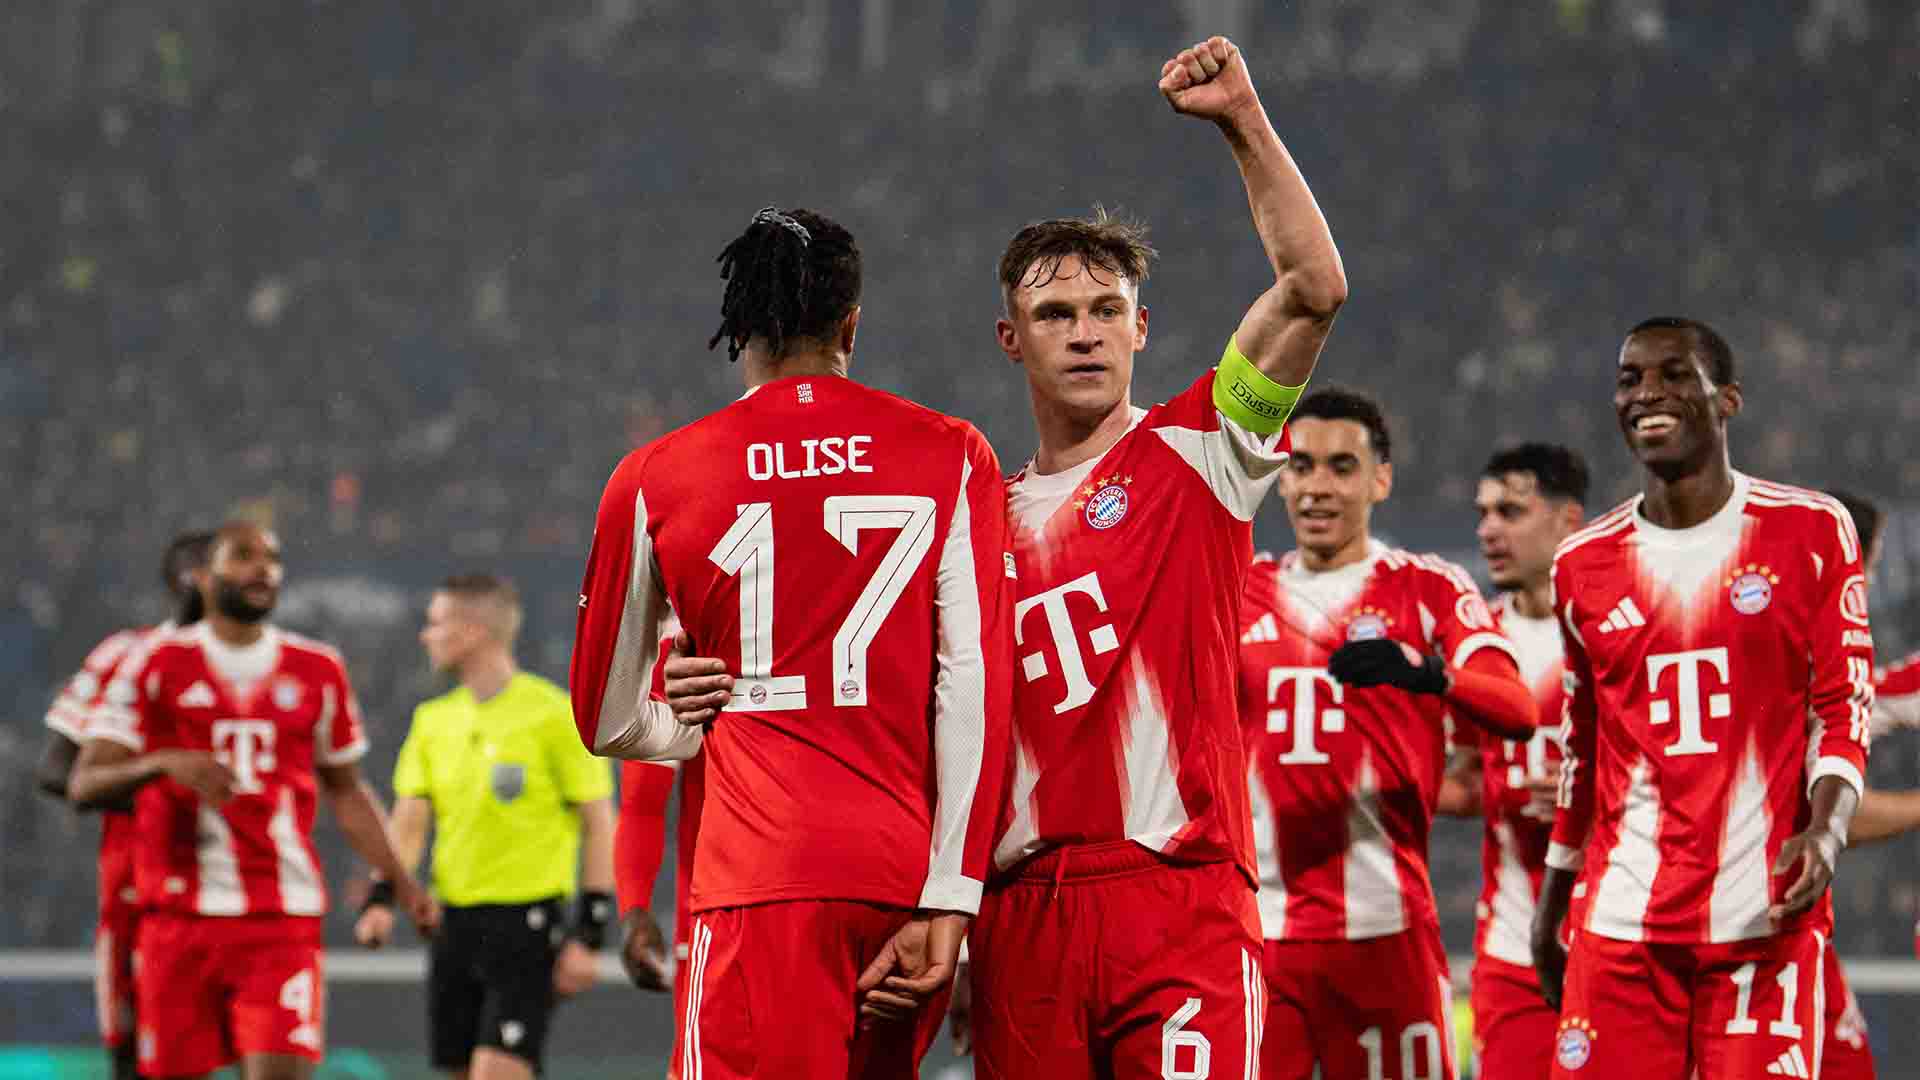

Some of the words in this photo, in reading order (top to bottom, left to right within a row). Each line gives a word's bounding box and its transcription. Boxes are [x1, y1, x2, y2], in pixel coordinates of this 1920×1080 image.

[1230, 381, 1281, 417] RESPECT
[747, 435, 873, 481] OLISE
[1096, 488, 1123, 502] BAYERN
[708, 495, 937, 712] 17
[280, 968, 315, 1025] 4
[1725, 962, 1803, 1040] 11
[1161, 997, 1211, 1080] 6
[1358, 1021, 1443, 1080] 10
